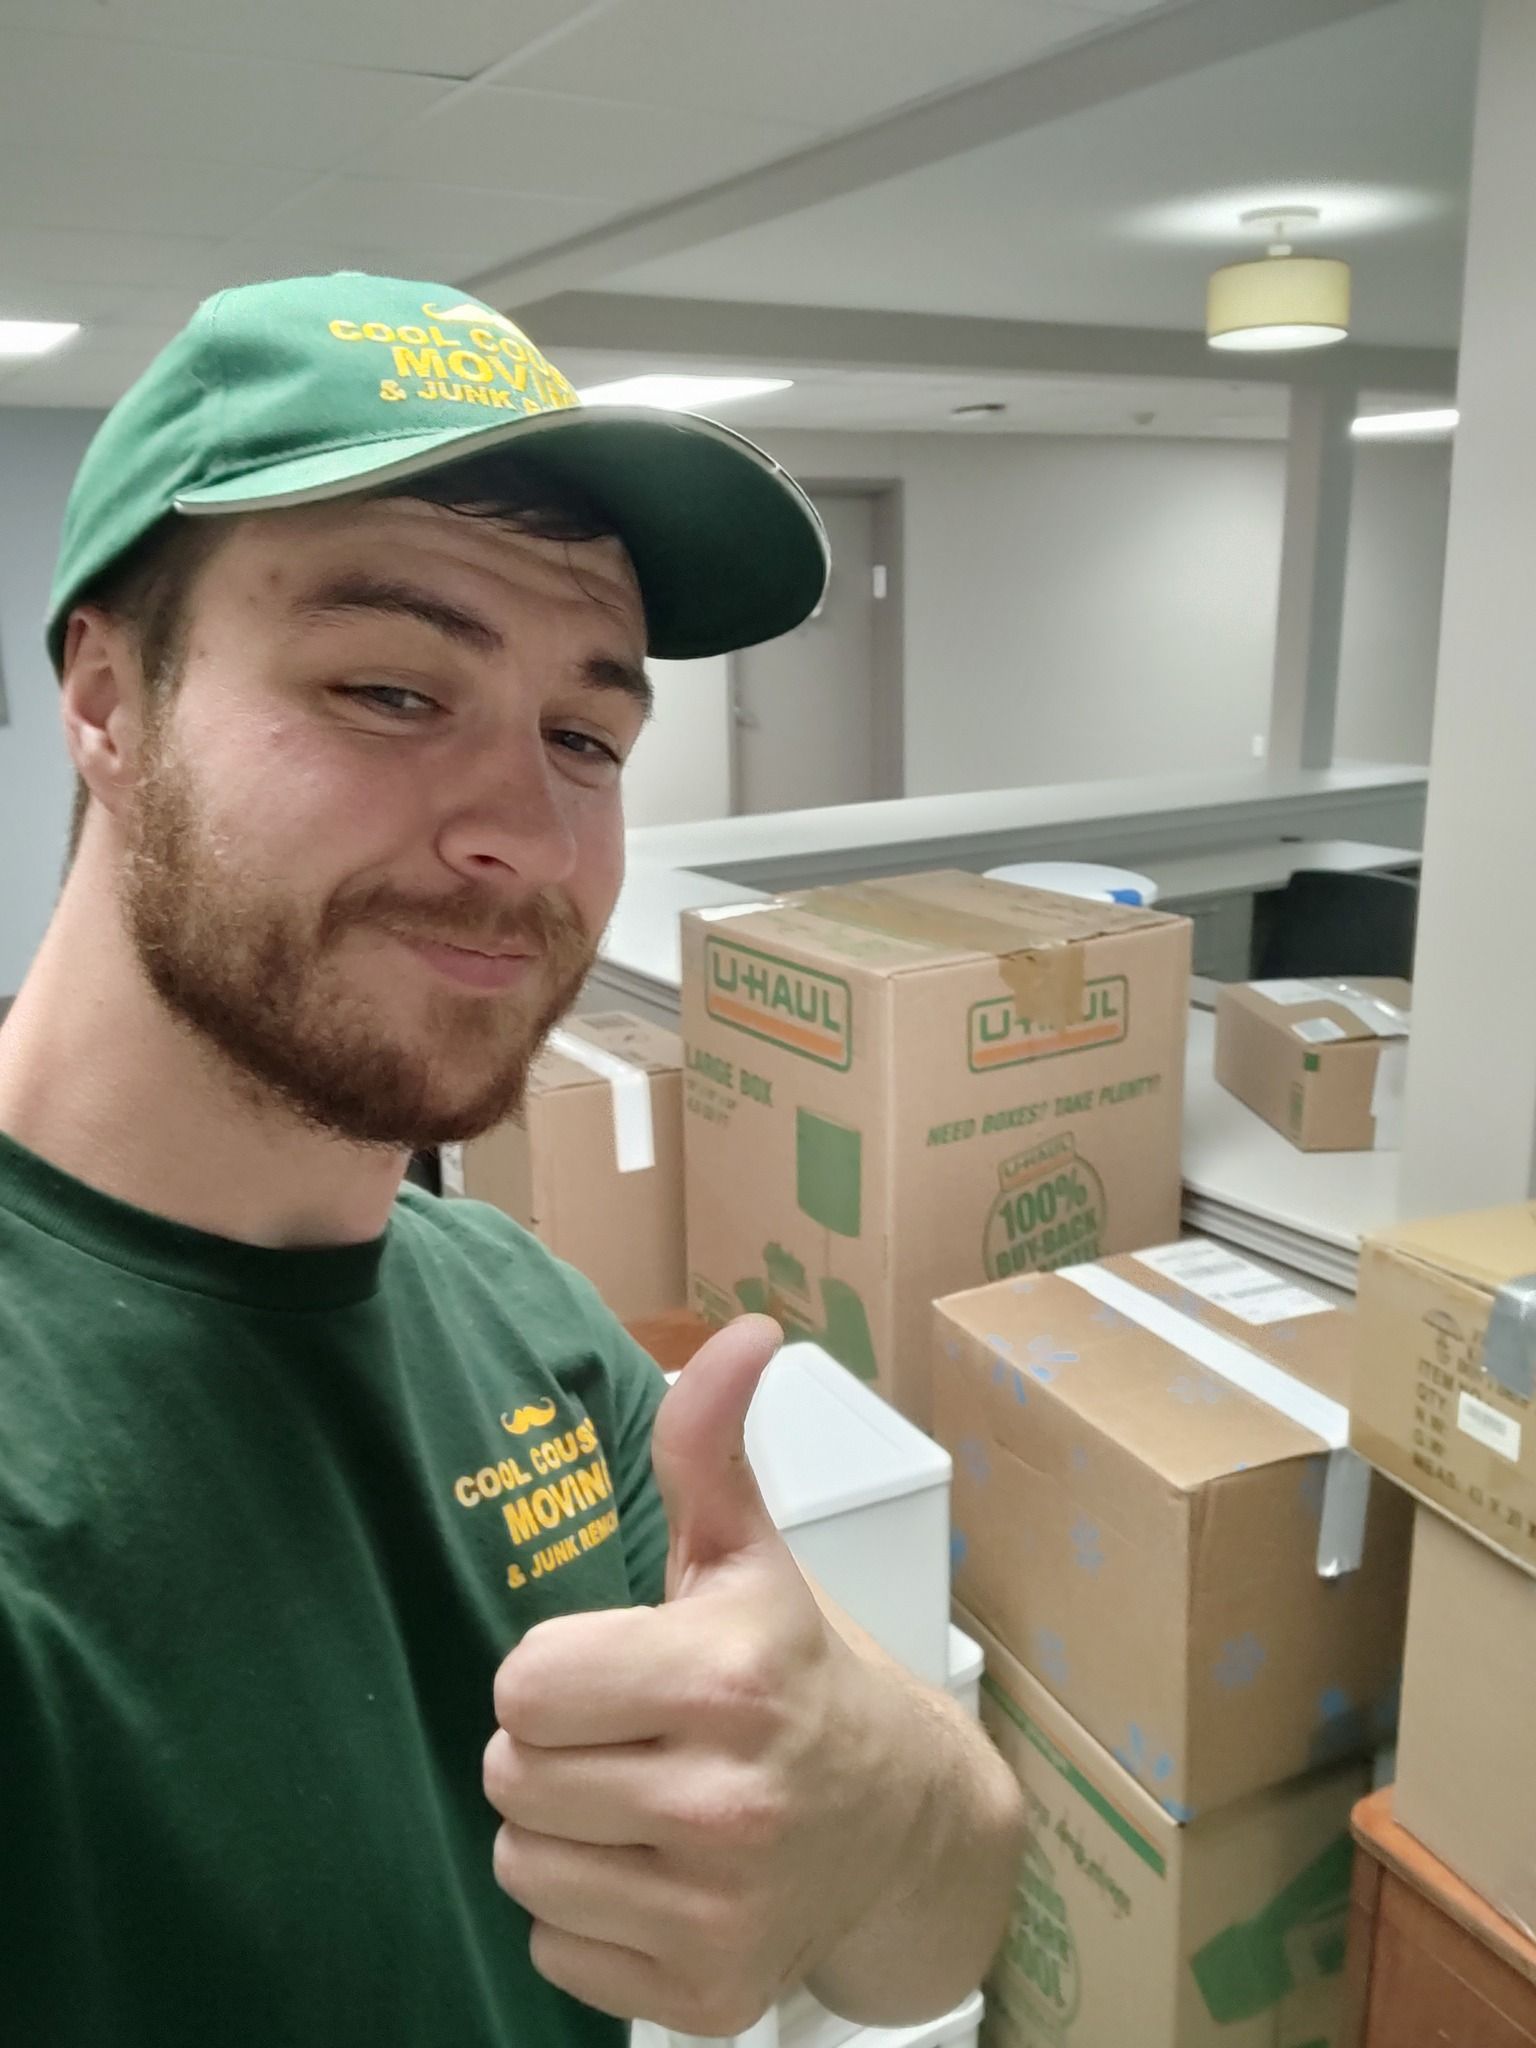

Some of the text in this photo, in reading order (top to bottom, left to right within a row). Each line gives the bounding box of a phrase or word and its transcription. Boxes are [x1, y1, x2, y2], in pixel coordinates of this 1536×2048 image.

[328, 319, 461, 348] COOL
[380, 379, 407, 401] &
[417, 380, 518, 411] JUNK
[713, 951, 841, 1033] U-HAUL
[926, 1117, 976, 1147] NEED
[1054, 1090, 1094, 1118] TAKE
[999, 1165, 1088, 1242] 100%
[455, 1458, 533, 1507] COOL
[502, 1460, 613, 1545] MOVIN
[507, 1563, 527, 1588] &
[531, 1535, 581, 1578] JUNK
